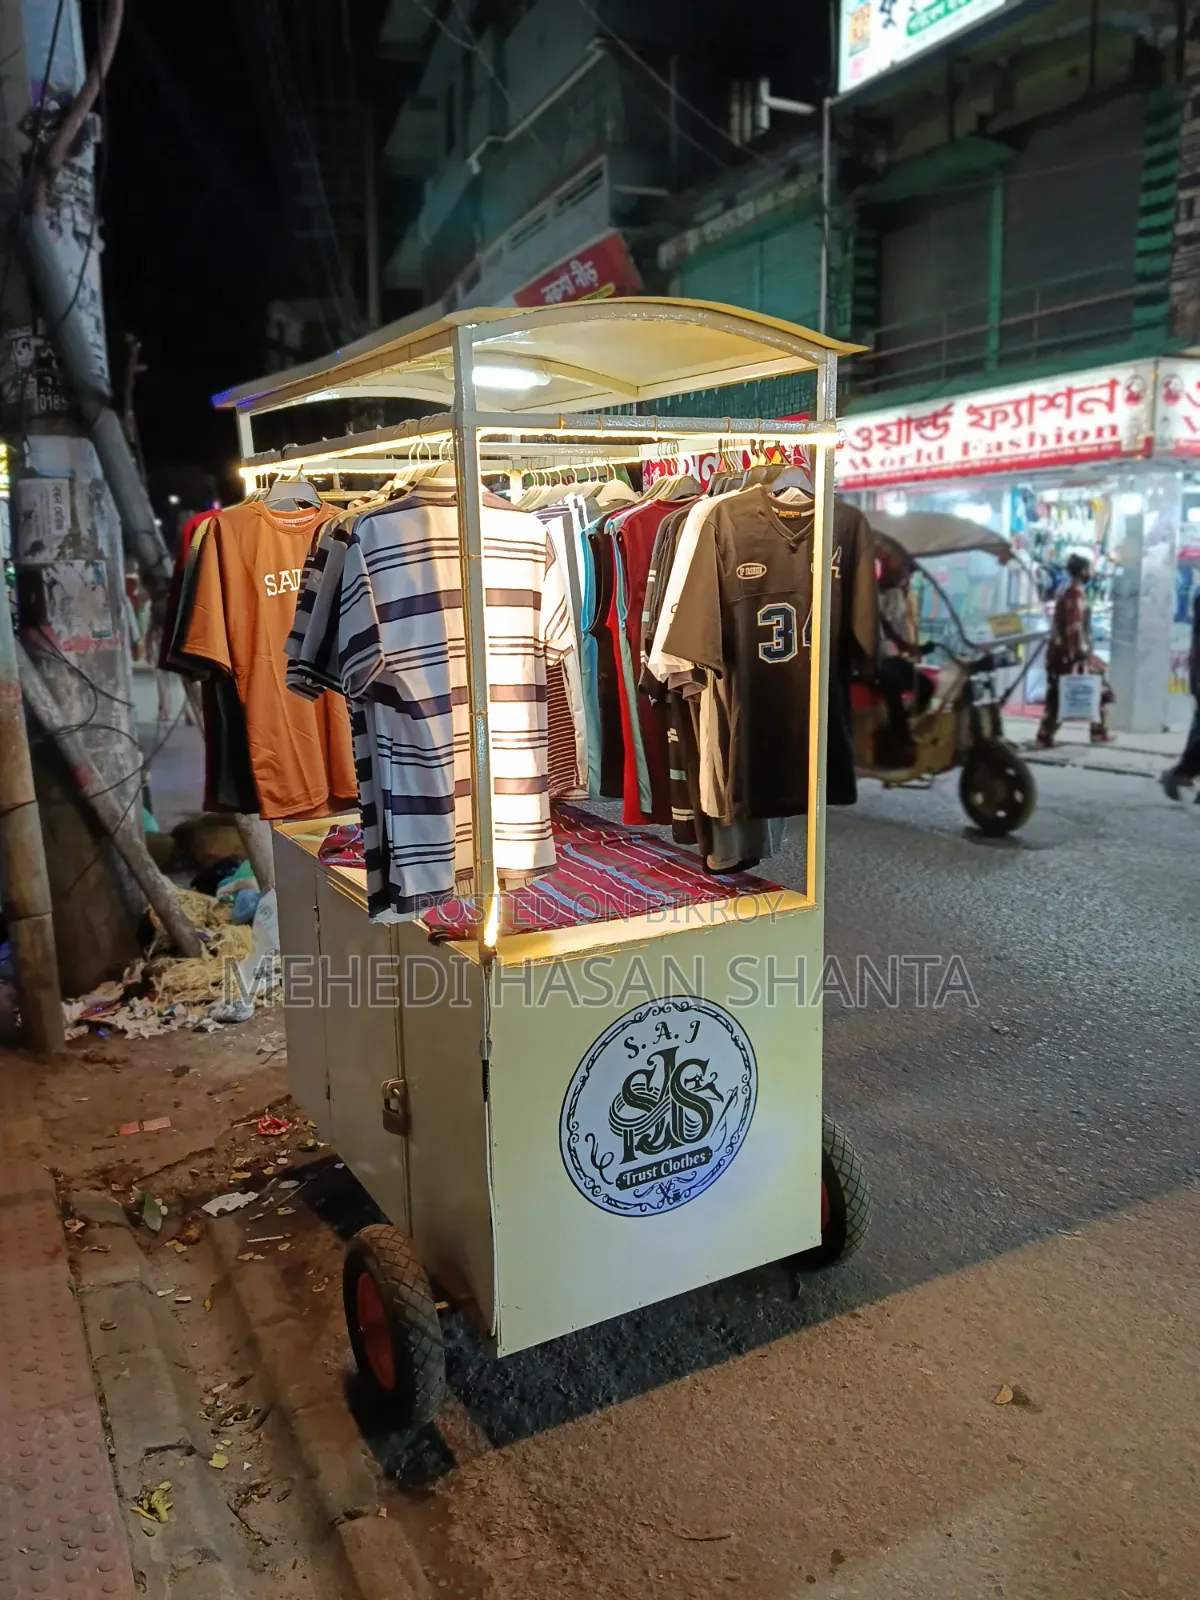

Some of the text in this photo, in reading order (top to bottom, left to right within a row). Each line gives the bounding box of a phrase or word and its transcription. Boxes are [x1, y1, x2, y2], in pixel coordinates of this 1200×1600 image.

[967, 377, 1121, 431] ফ্যাশন
[848, 444, 945, 471] World
[961, 421, 1119, 458] Fashion
[622, 1152, 706, 1186] Trust Clothes
